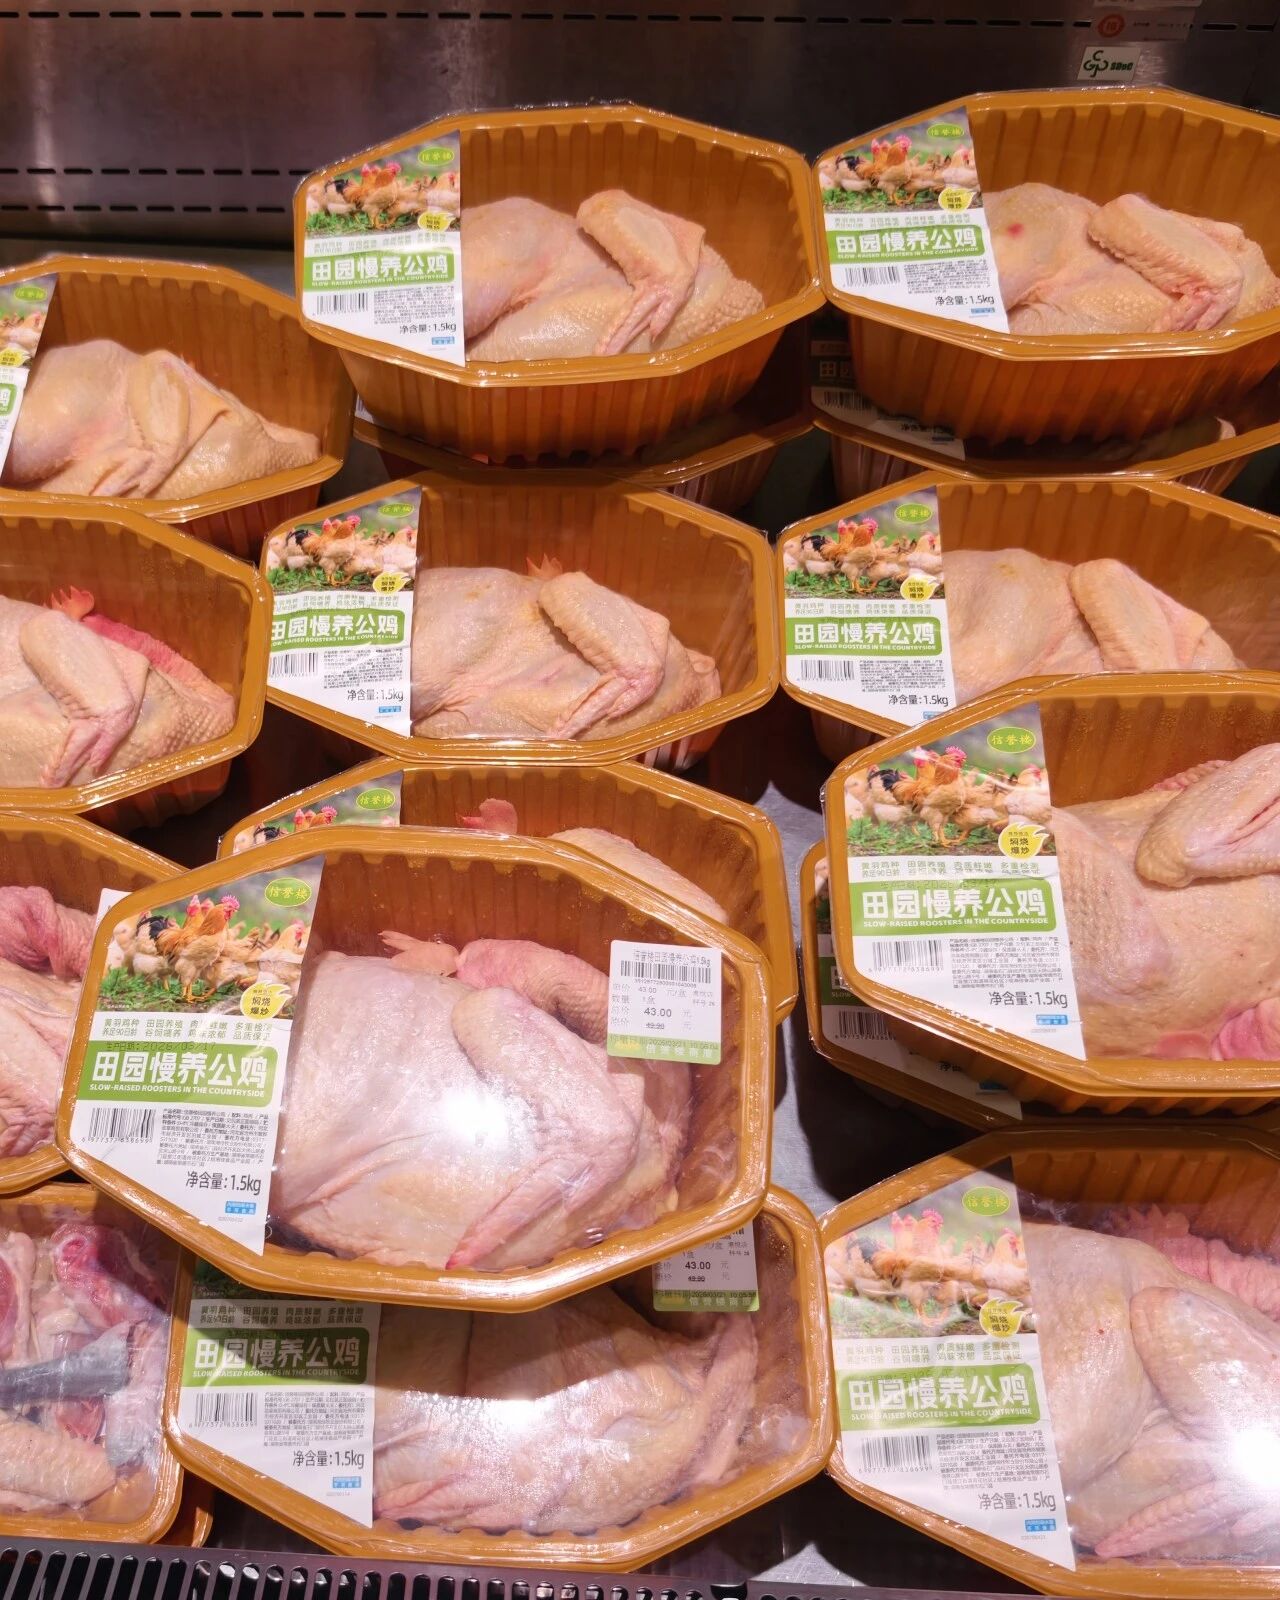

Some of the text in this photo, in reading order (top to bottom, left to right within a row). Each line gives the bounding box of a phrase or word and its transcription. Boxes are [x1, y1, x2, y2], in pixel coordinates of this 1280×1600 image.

[835, 227, 977, 254] 田园慢养公鸡
[312, 254, 448, 281] 田园慢养公鸡
[935, 295, 995, 305] 净含量:1.5kg
[399, 321, 457, 334] 净含量:1.5kg
[272, 613, 398, 641] 田园慢养公鸡
[794, 622, 936, 645] 田园慢养公鸡
[347, 689, 404, 702] 净含量:1.5kg
[888, 695, 949, 707] 净含量:1.5kg
[862, 887, 1047, 919] 田园慢养公鸡
[863, 919, 919, 928] SLOW-RAISED
[920, 918, 963, 927] ROOSTERS
[973, 917, 990, 925] THE
[990, 916, 1048, 925] COUNTRYSIDE
[989, 991, 1068, 1008] 净含量:1.5kg
[643, 1007, 672, 1018] 43.00
[93, 1051, 268, 1089] 田园慢养公鸡
[90, 1083, 141, 1093] SLOW-RAISED
[141, 1084, 182, 1094] ROOSTERS
[192, 1086, 208, 1094] THE
[208, 1087, 265, 1098] COUNTRYSIDE
[186, 1170, 262, 1196] 净含量:1.5kg
[685, 1261, 711, 1270] 43.00
[195, 1337, 360, 1369] 田园慢养公鸡
[243, 1369, 282, 1377] ROOSTERS
[307, 1368, 359, 1376] COUNTRYSIDE
[848, 1374, 1031, 1411] 田园慢养公鸡
[907, 1410, 949, 1419] ROOSTERS
[959, 1410, 976, 1418] THE
[976, 1407, 1032, 1417] COUNTRYSIDE
[292, 1450, 365, 1470] 净含量:1.5kg
[978, 1491, 1057, 1512] 净含量:1.5kg
